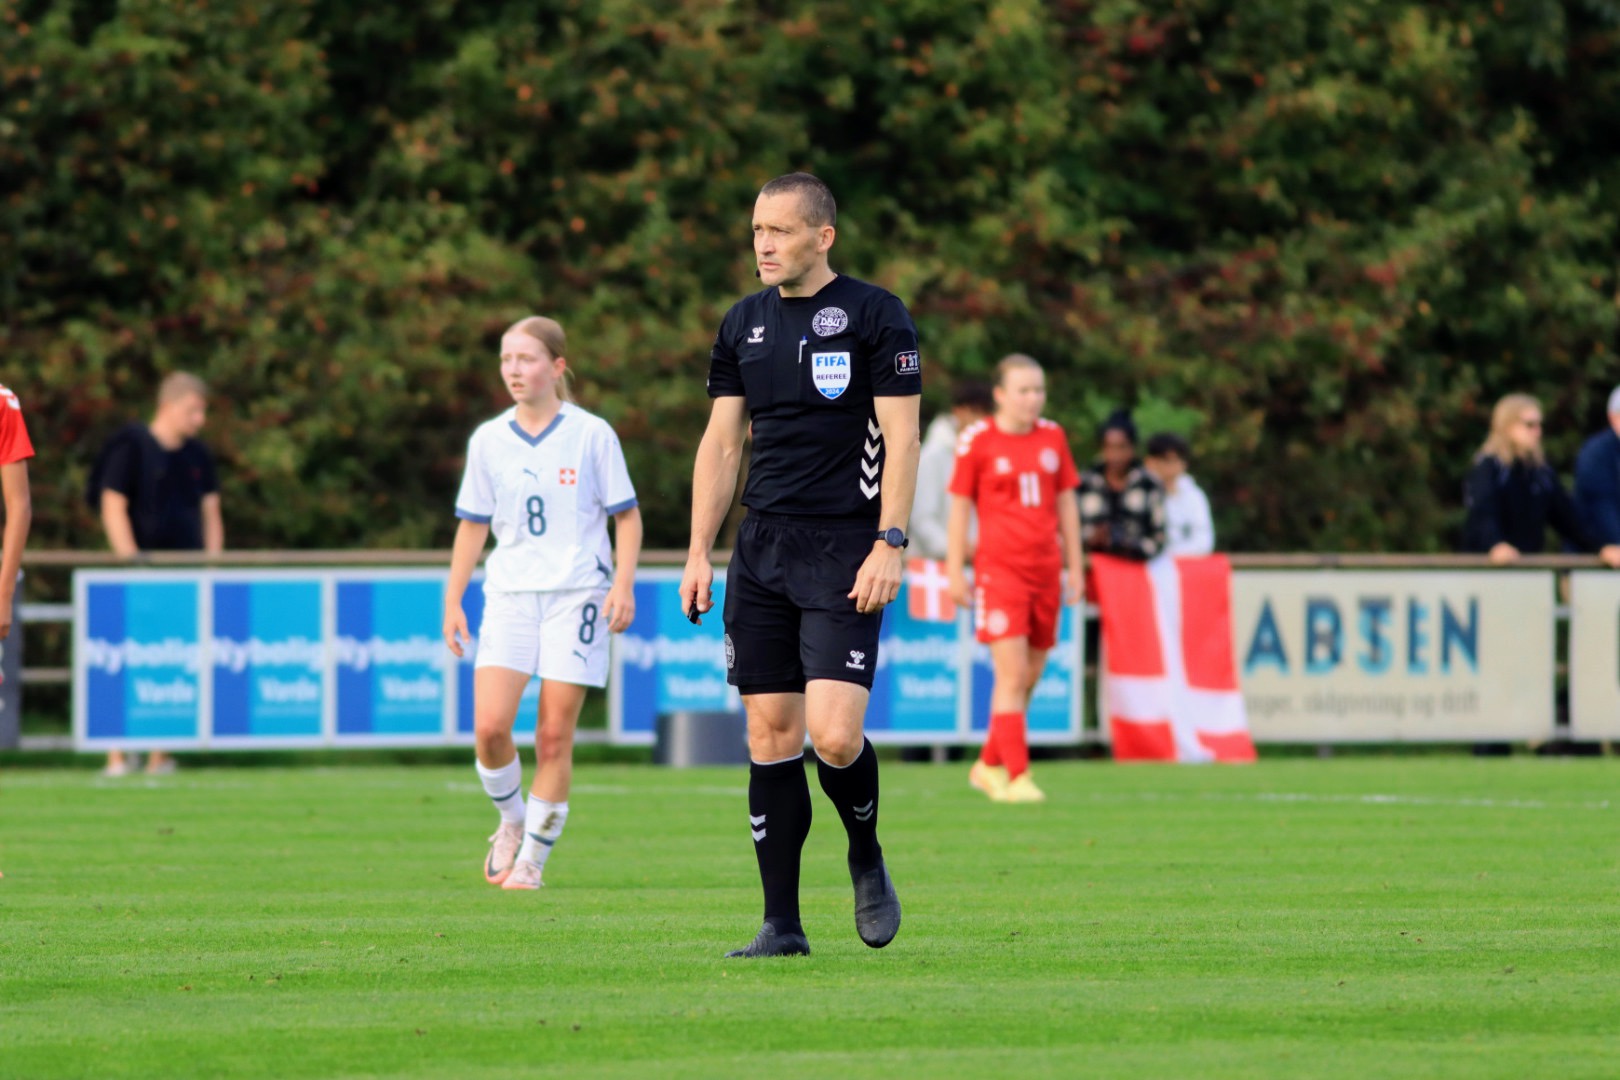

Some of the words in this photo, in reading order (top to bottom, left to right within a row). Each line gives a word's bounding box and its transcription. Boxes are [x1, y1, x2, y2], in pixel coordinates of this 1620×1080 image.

[819, 316, 841, 327] DBU
[815, 355, 847, 367] FIFA
[1018, 472, 1041, 507] 11
[526, 495, 547, 536] 8
[579, 603, 598, 645] 8
